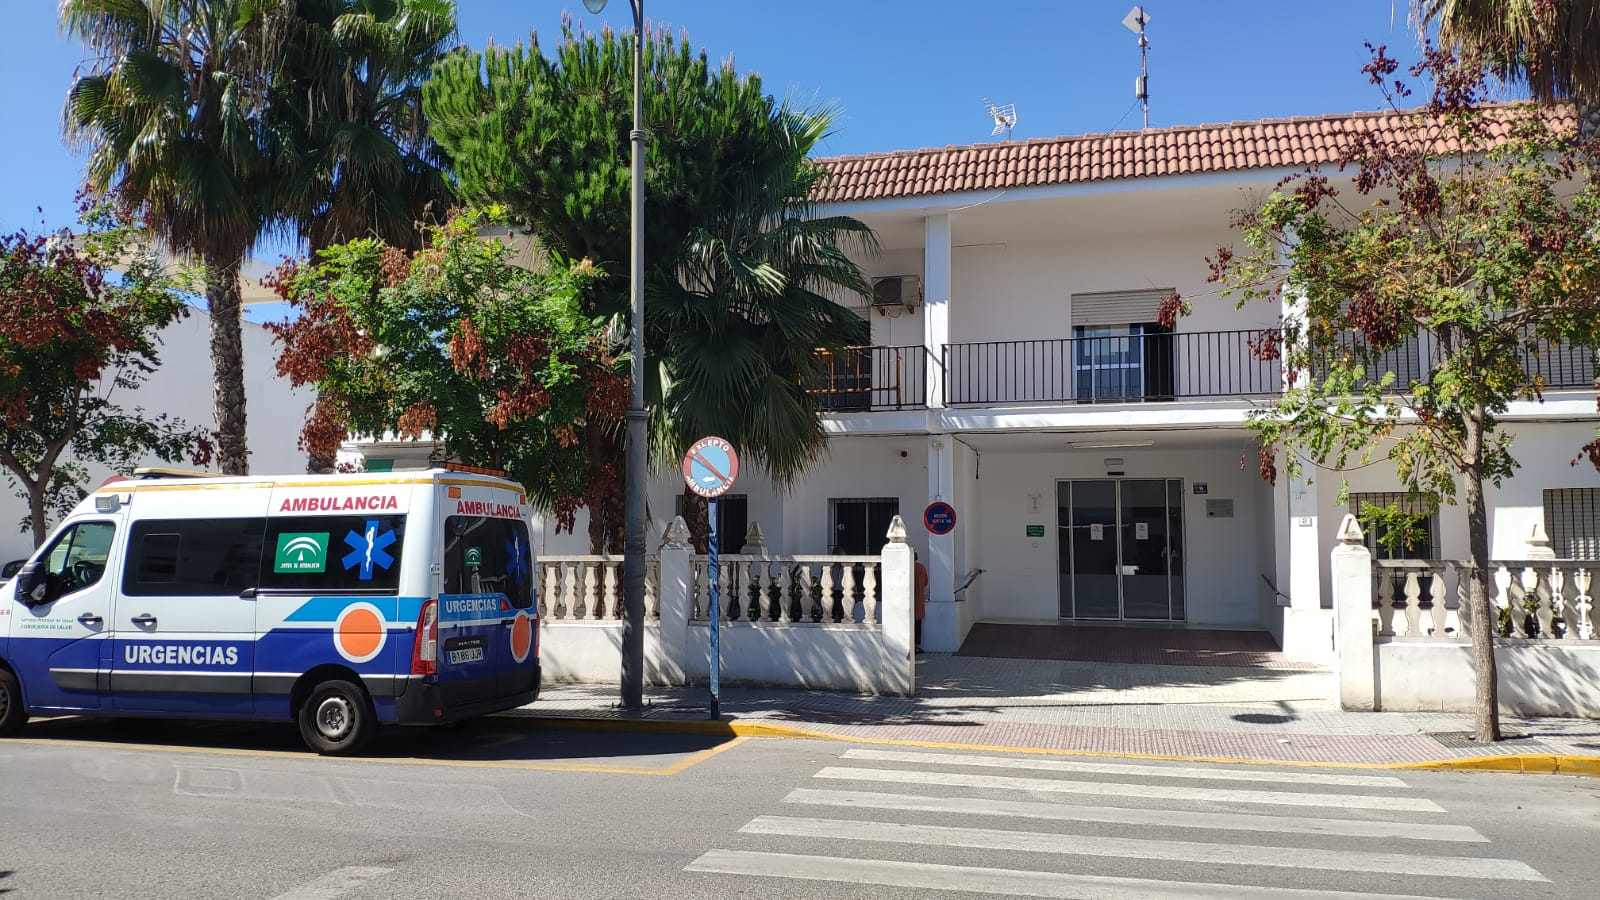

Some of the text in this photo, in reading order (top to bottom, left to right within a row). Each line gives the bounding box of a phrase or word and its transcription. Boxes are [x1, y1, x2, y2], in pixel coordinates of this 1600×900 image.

[686, 475, 735, 497] AMBULANCIA
[279, 495, 398, 512] AMBULANCIA
[456, 500, 521, 519] AMBULANCIA
[445, 598, 497, 613] URGENCIAS
[125, 645, 238, 666] URGENCIAS
